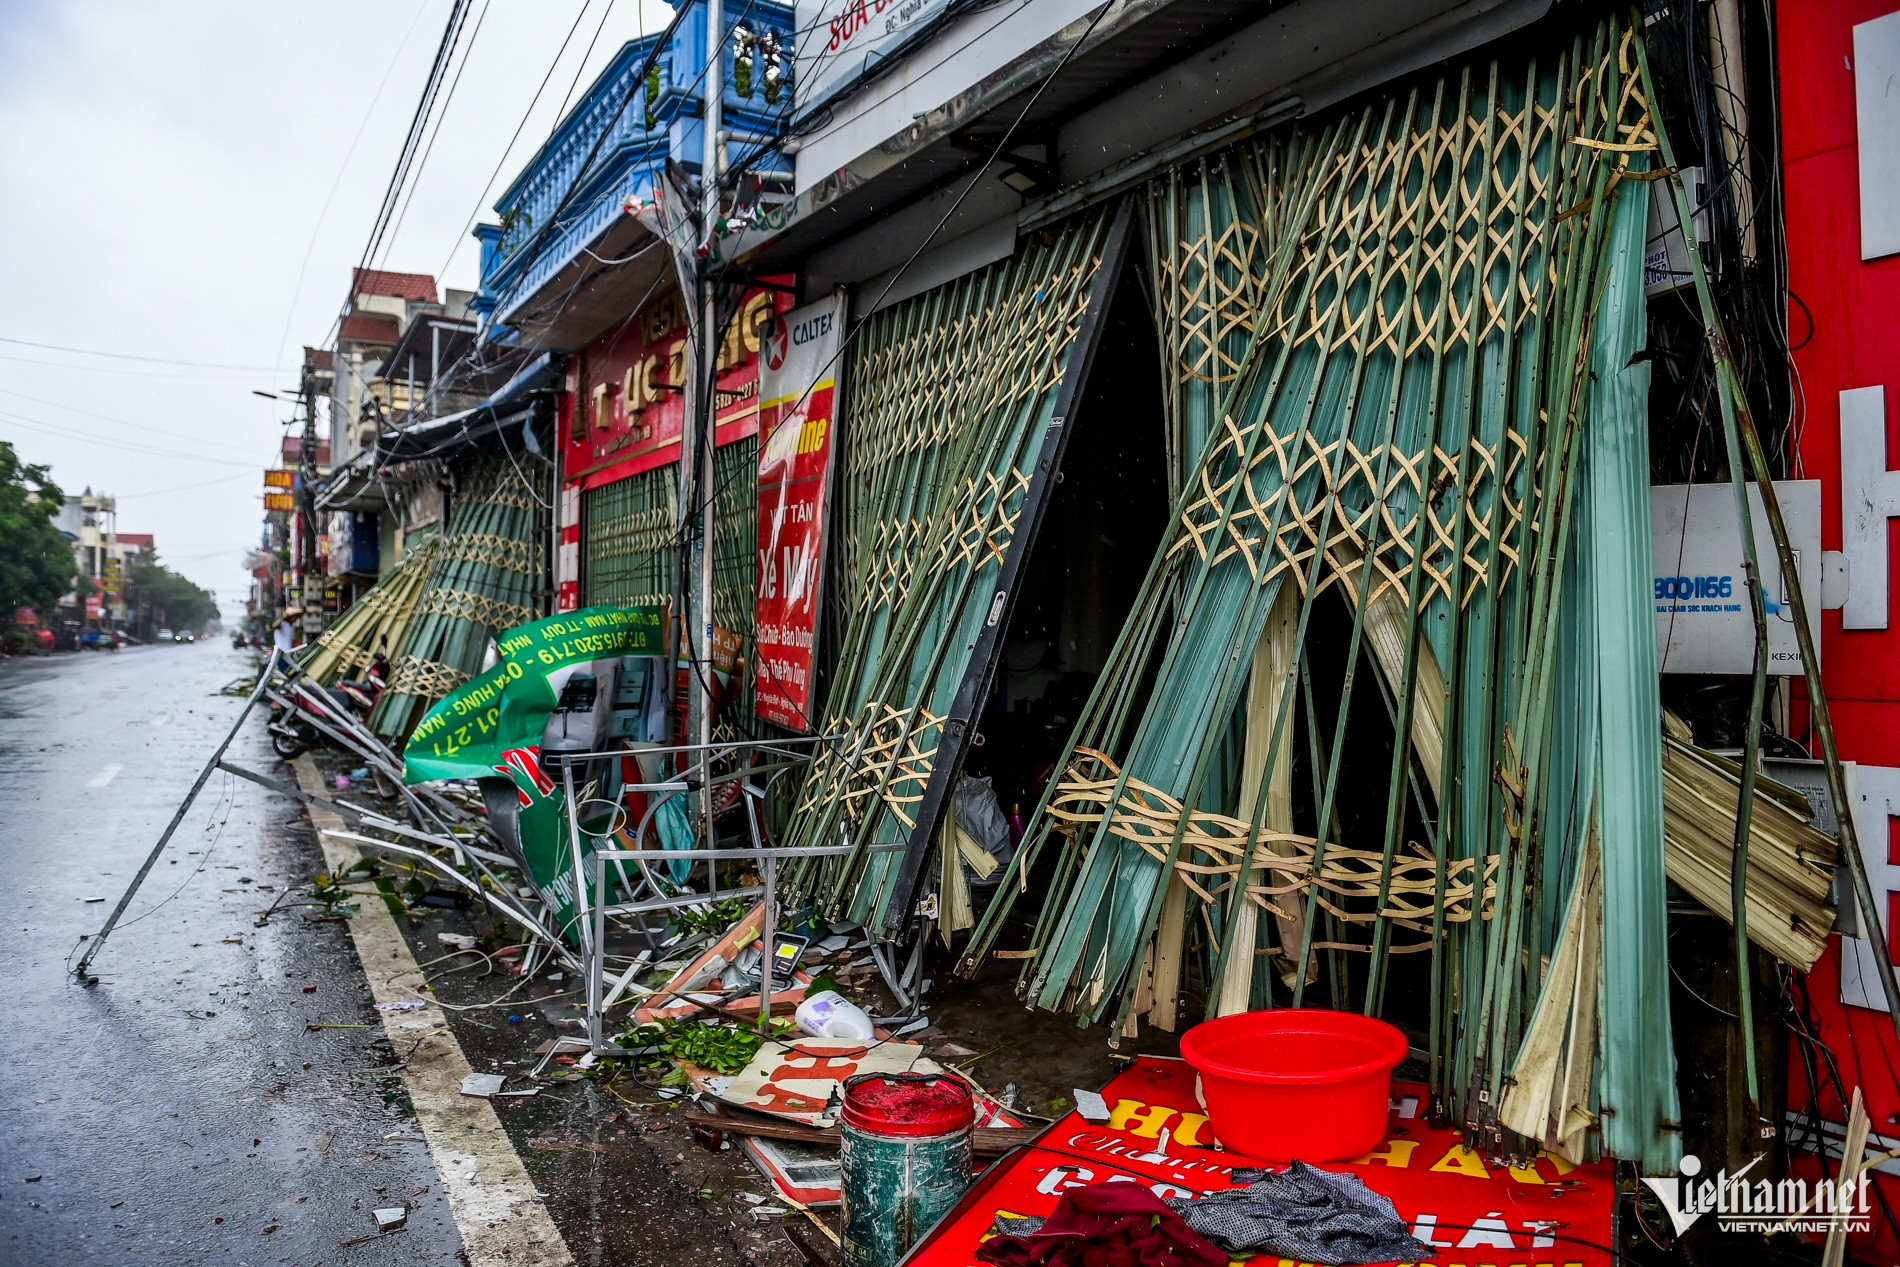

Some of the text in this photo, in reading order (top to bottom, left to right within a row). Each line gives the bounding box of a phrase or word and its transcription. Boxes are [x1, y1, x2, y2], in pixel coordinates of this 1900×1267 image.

[793, 310, 836, 346] CALTEX
[790, 499, 814, 524] TÂN
[783, 545, 819, 615] My
[538, 631, 628, 665] 915.520.719
[782, 621, 795, 647] Bảo
[1411, 1211, 1558, 1249] LÁT
